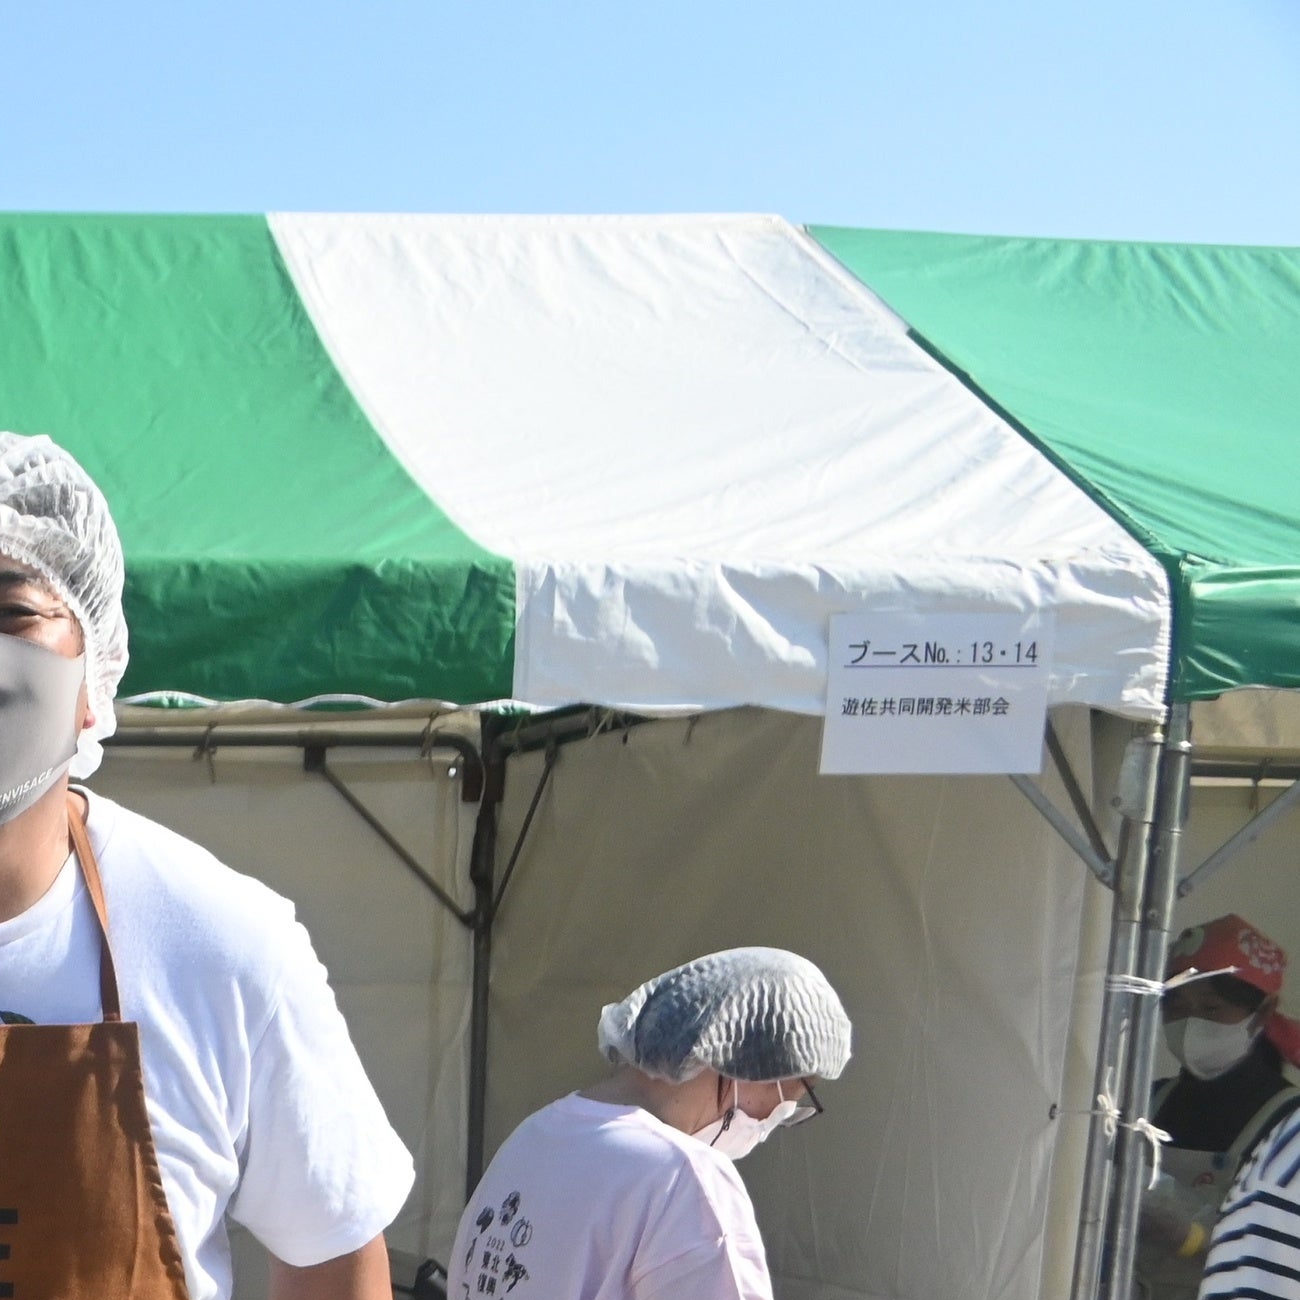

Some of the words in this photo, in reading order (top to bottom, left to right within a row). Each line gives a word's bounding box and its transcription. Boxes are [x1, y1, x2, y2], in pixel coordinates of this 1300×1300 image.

[842, 697, 1010, 716] 遊佐共同開発米部会
